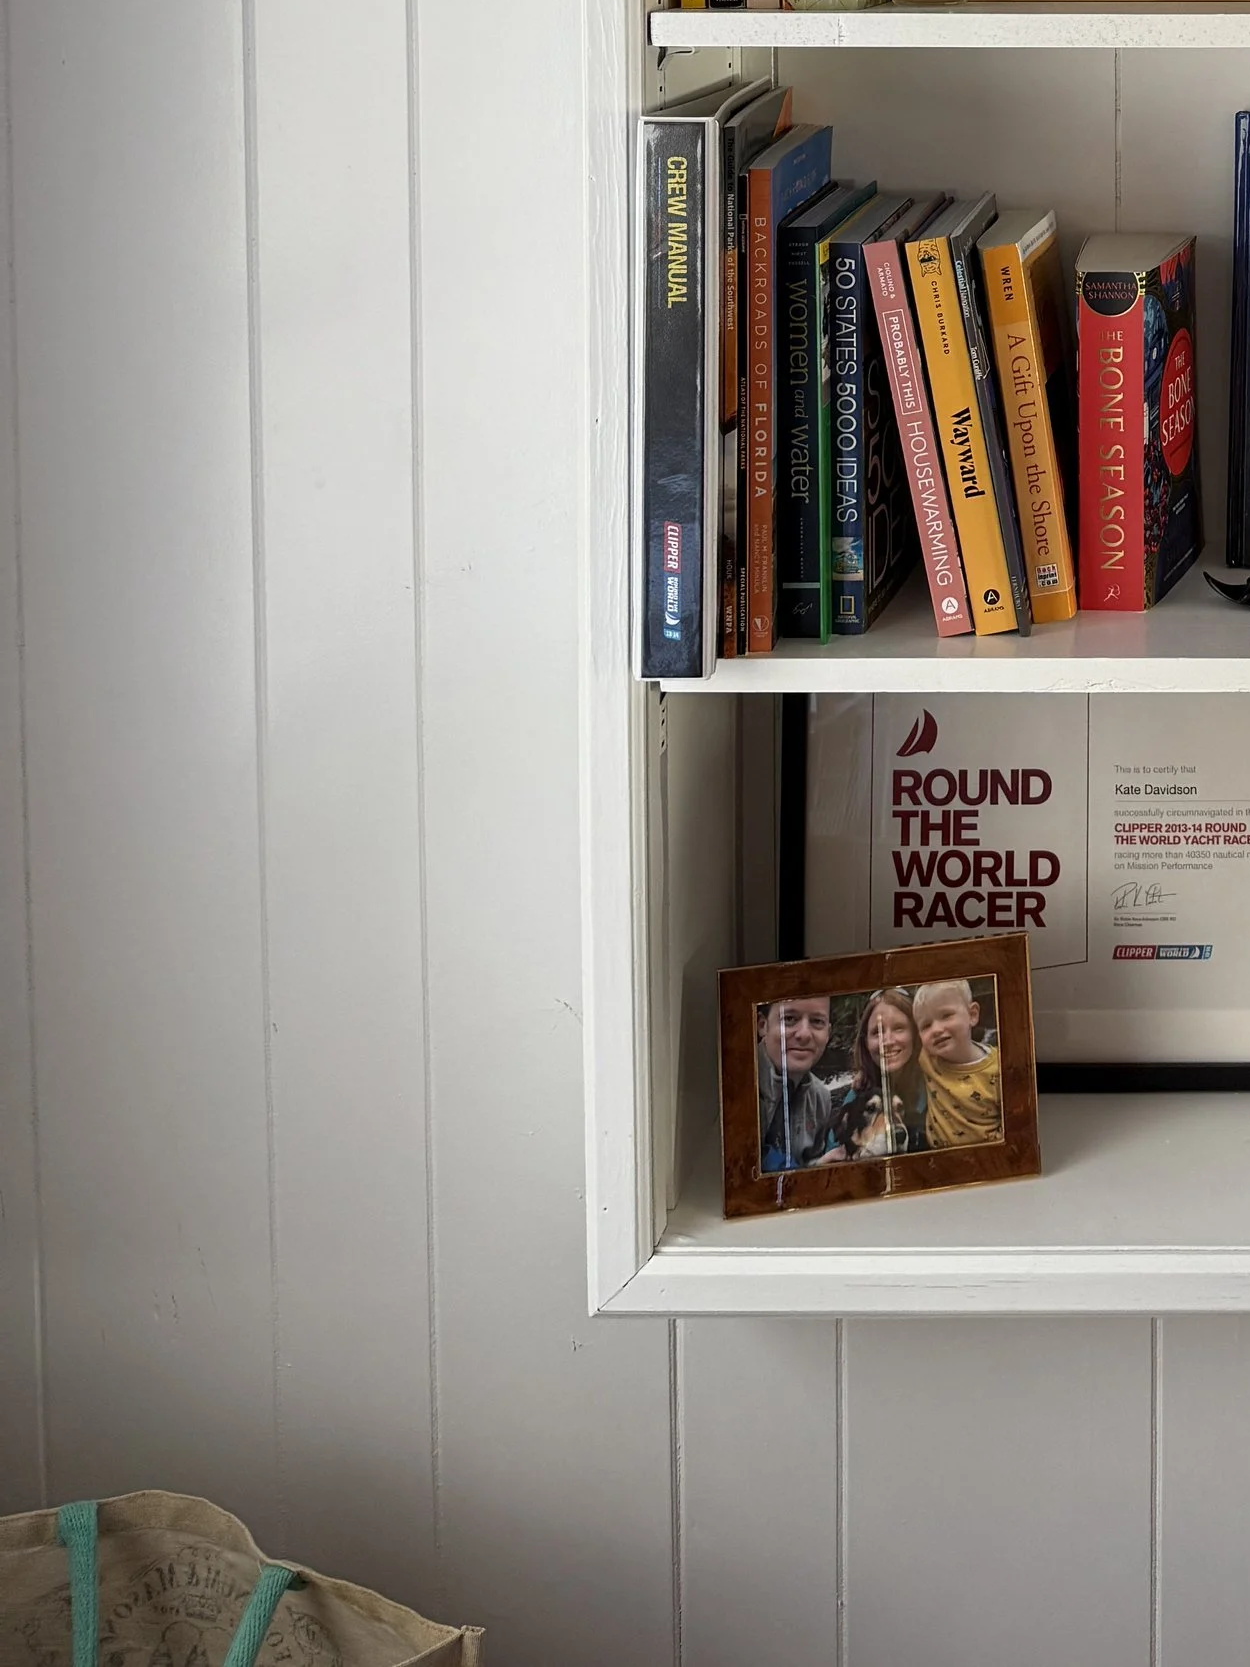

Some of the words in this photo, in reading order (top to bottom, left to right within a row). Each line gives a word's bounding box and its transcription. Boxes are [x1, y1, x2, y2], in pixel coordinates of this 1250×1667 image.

[667, 156, 687, 217] CREW
[667, 222, 688, 309] MANUAL
[754, 218, 767, 350] BACKROADS
[836, 258, 855, 289] 50
[1001, 266, 1014, 301] WREN
[1085, 281, 1137, 291] SAMANTHA
[1088, 291, 1134, 300] SHANNON
[836, 296, 857, 375] STATES
[888, 316, 910, 378] PROBABLY
[754, 363, 767, 389] OF
[902, 381, 915, 409] THIS
[1100, 346, 1125, 432] BONE
[836, 383, 857, 451] 5000
[754, 403, 767, 498] FLORIDA
[836, 457, 858, 523] IDEAS
[907, 421, 953, 586] HOUSEWARMING
[1100, 444, 1125, 571] SEASON
[892, 768, 1053, 806] ROUND
[1115, 784, 1141, 795] Kate
[1145, 784, 1197, 795] Davidson
[893, 809, 980, 847] THE
[1114, 823, 1163, 833] CLIPPER
[1165, 823, 1203, 833] 2013-14
[1205, 823, 1247, 833] ROUND
[1115, 835, 1137, 845] THE
[1139, 835, 1181, 845] WORLD
[1183, 835, 1221, 845] YACHT
[892, 850, 1060, 887] WORLD
[894, 890, 1047, 928] RACER
